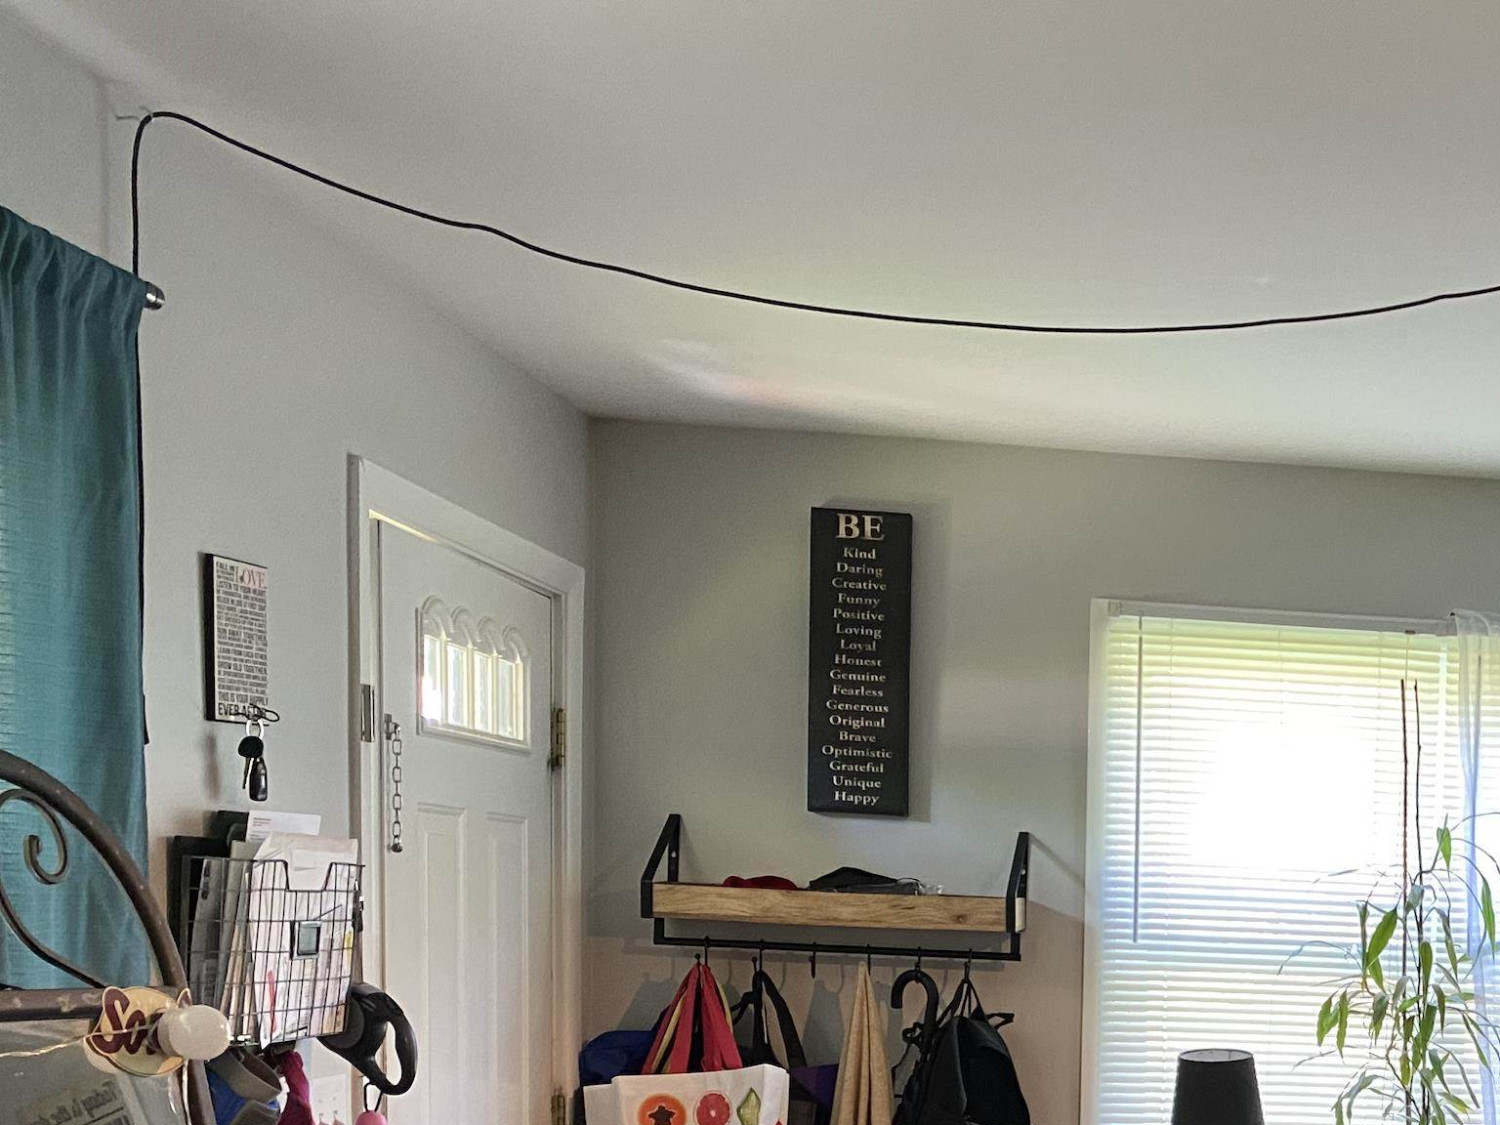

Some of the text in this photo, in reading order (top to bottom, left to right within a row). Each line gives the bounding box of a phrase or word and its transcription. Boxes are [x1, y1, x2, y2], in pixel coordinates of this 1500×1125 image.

[836, 512, 884, 540] BE
[843, 547, 876, 559] Kind
[836, 562, 884, 578] Daring
[831, 577, 887, 591] Creative
[838, 592, 880, 608] Funny
[833, 607, 885, 621] Positive
[835, 623, 882, 639] Loving
[840, 639, 876, 653] Loyal
[835, 653, 882, 666] Honest
[829, 669, 886, 682] Genuine
[832, 684, 883, 697] Fearless
[826, 699, 889, 713] Generous
[829, 715, 885, 729] Original
[839, 731, 876, 743] Brave
[821, 745, 894, 759] Optimistic
[829, 760, 884, 773] Grateful
[833, 775, 881, 790] Unique
[834, 791, 880, 806] Happy
